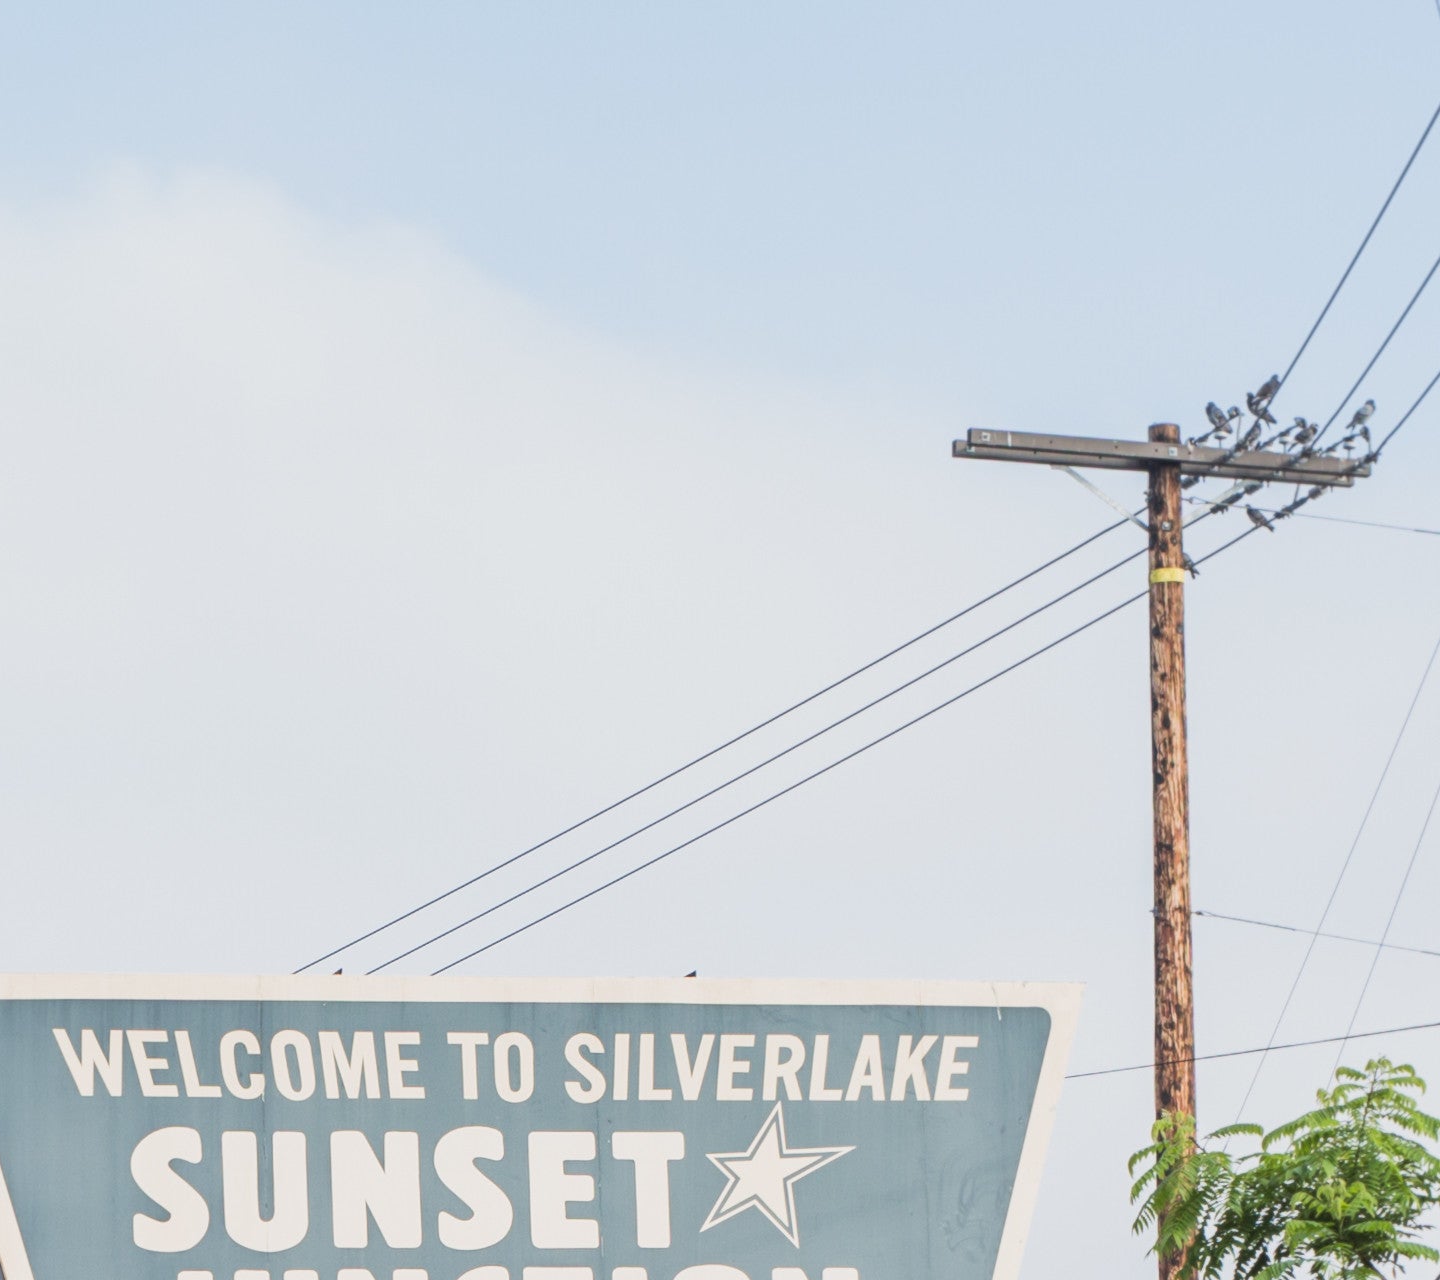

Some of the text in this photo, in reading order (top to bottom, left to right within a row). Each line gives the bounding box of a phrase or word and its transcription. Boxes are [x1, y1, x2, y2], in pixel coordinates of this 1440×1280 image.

[52, 1027, 980, 1104] WELCOME TO SILVERLAKE
[130, 1126, 684, 1252] SUNSET
